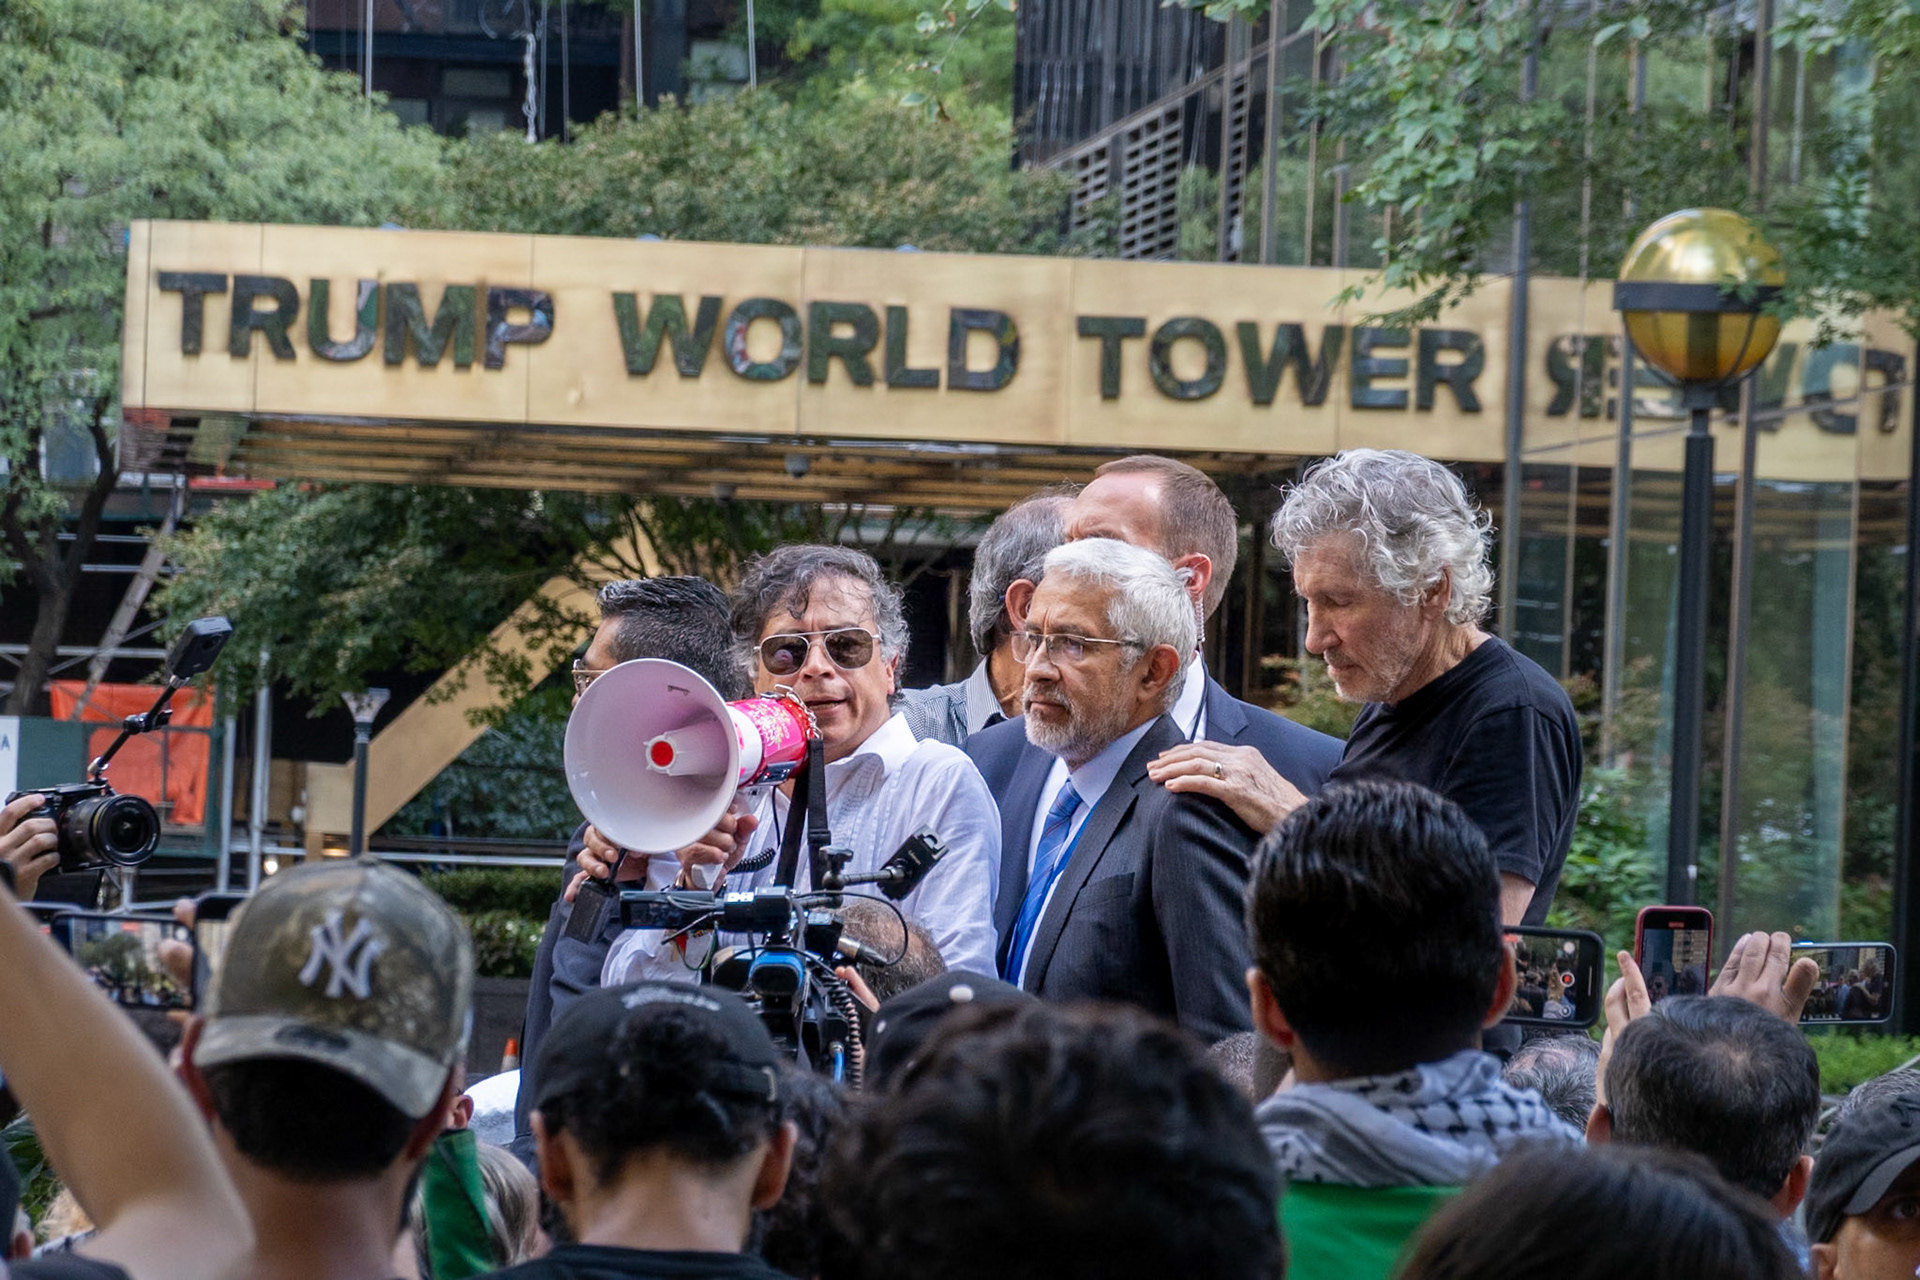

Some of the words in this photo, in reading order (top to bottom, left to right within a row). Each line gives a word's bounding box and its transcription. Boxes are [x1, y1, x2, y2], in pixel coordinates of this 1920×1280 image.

[157, 271, 555, 370] TRUMP
[611, 292, 1020, 391] WORLD
[1076, 315, 1485, 412] TOWER
[298, 907, 381, 1000] NY
